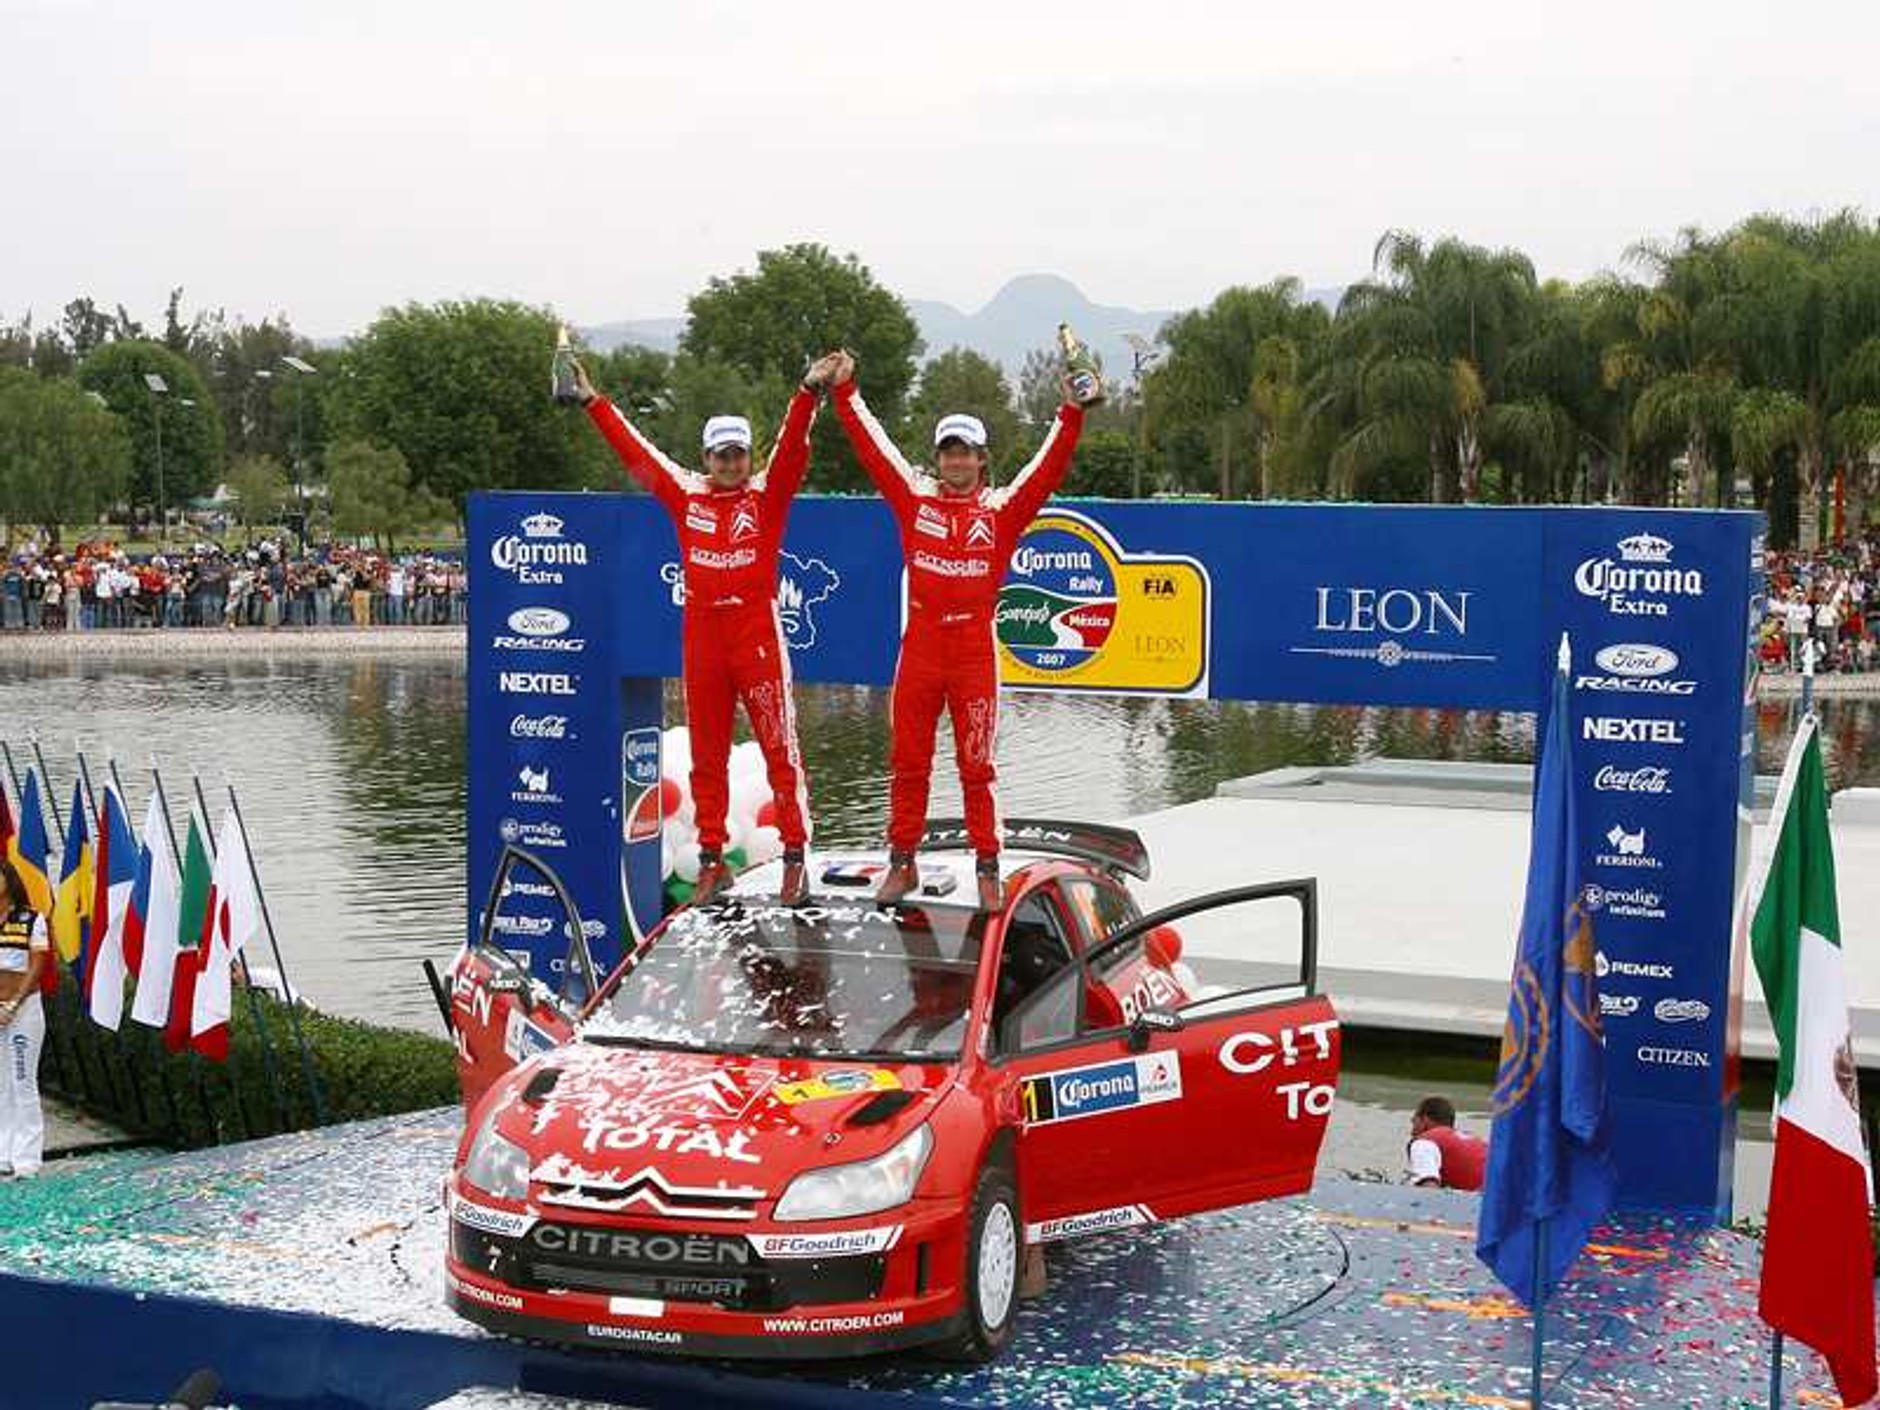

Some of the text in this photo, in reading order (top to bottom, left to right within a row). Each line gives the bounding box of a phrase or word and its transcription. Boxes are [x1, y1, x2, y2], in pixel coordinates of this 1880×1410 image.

[491, 536, 587, 573] Corona
[1011, 547, 1092, 577] Corona
[519, 566, 563, 584] Extra
[1069, 577, 1103, 593] Rally
[1575, 557, 1704, 600] Corona
[1315, 587, 1473, 635] LEON
[1610, 594, 1668, 615] Extra
[493, 636, 586, 651] RACING
[1036, 652, 1067, 666] 2007
[1612, 650, 1663, 669] Ford
[500, 671, 577, 695] NEXTEL
[1575, 676, 1699, 695] RACING
[1583, 716, 1685, 744] NEXTEL
[1604, 887, 1661, 907] prodigy
[1612, 960, 1674, 979] PEMEX
[1637, 1046, 1711, 1066] CITIZEN
[1059, 1073, 1135, 1108] Corona
[579, 1119, 762, 1164] TOTAL
[533, 1224, 749, 1264] CITROËN
[762, 1232, 876, 1252] BFGoodrich
[763, 1310, 904, 1333] WWW.CITROEN.COM
